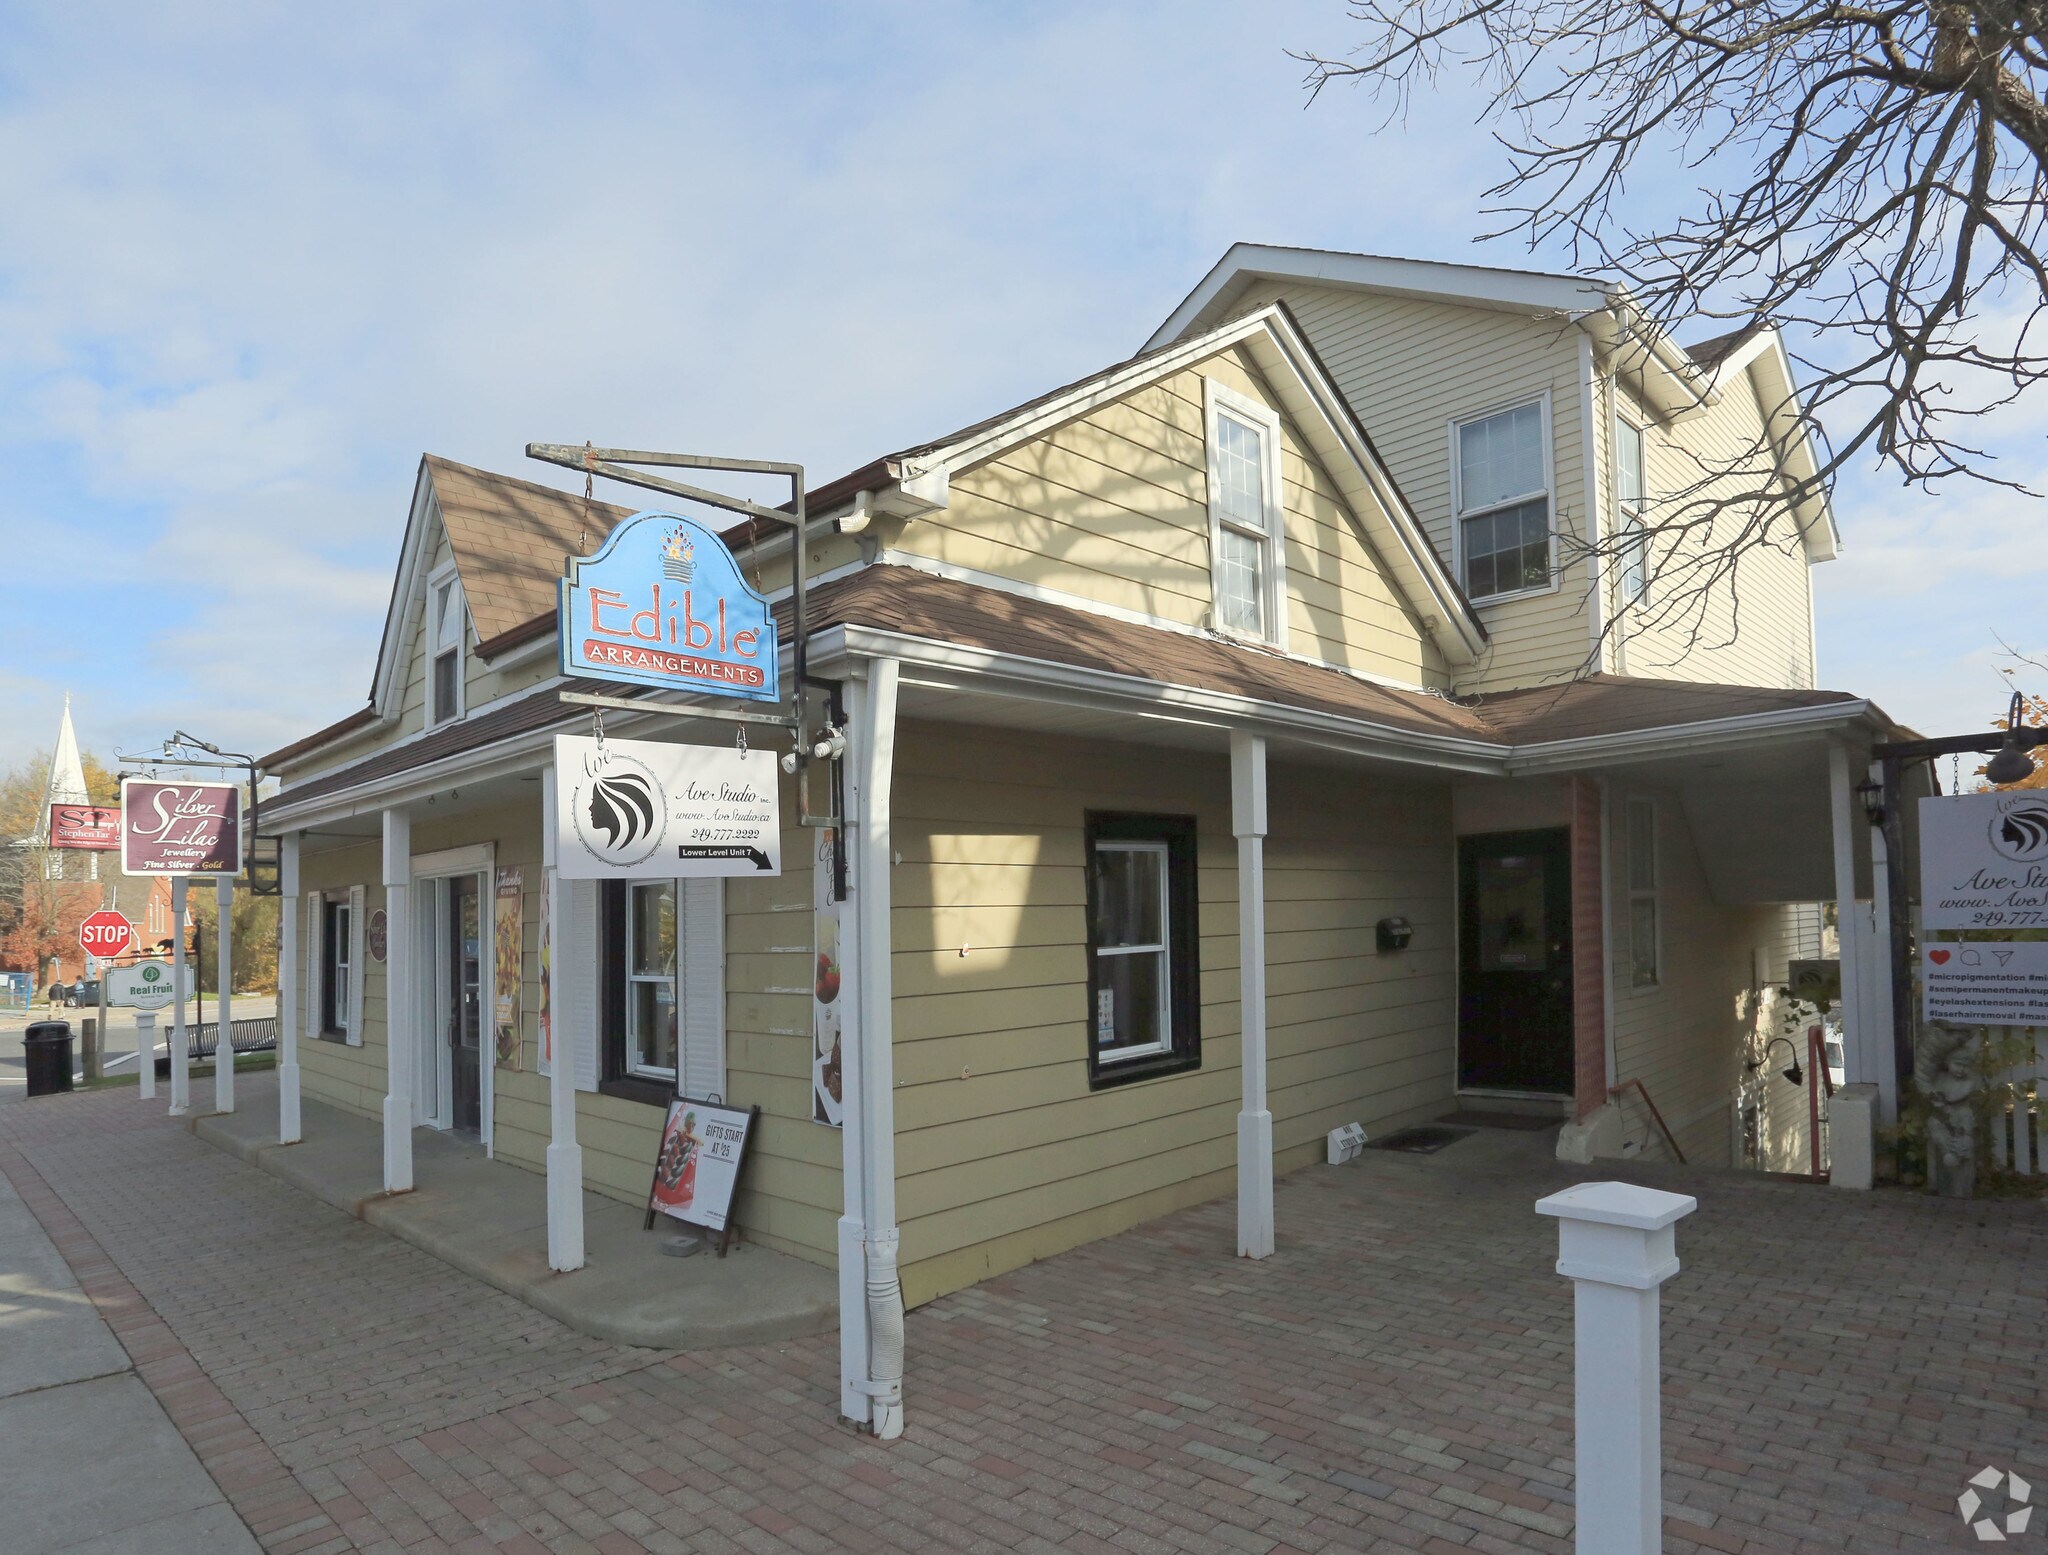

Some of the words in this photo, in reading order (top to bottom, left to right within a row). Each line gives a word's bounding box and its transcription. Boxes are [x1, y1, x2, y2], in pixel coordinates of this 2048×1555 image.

[589, 584, 758, 658] Edible
[589, 645, 758, 683] ARRANGEMENTS
[675, 781, 711, 801] Ave
[711, 782, 758, 803] Studio
[131, 787, 216, 834] Silver
[58, 829, 94, 838] Stephen
[152, 815, 219, 846] Lilac
[691, 828, 760, 842] 249.777.2222
[160, 849, 206, 859] Jewellery
[682, 849, 706, 857] Lower
[708, 849, 728, 857] Level
[730, 849, 745, 857] Unit
[747, 849, 752, 857] 7
[142, 861, 165, 870] Fine
[167, 861, 195, 869] Silver
[202, 861, 224, 870] Gold
[1953, 868, 2011, 891] Ave
[83, 925, 128, 943] STOP
[1928, 973, 2026, 982] #micropigmentation
[130, 986, 151, 995] Real
[152, 982, 173, 994] Fruit
[1928, 998, 2025, 1007] #eyelashextensions
[1928, 1010, 2016, 1020] #laserhairremoval
[705, 1124, 724, 1140] GIFTS
[724, 1128, 744, 1143] START
[711, 1142, 720, 1154] AT
[721, 1143, 730, 1157] $25
